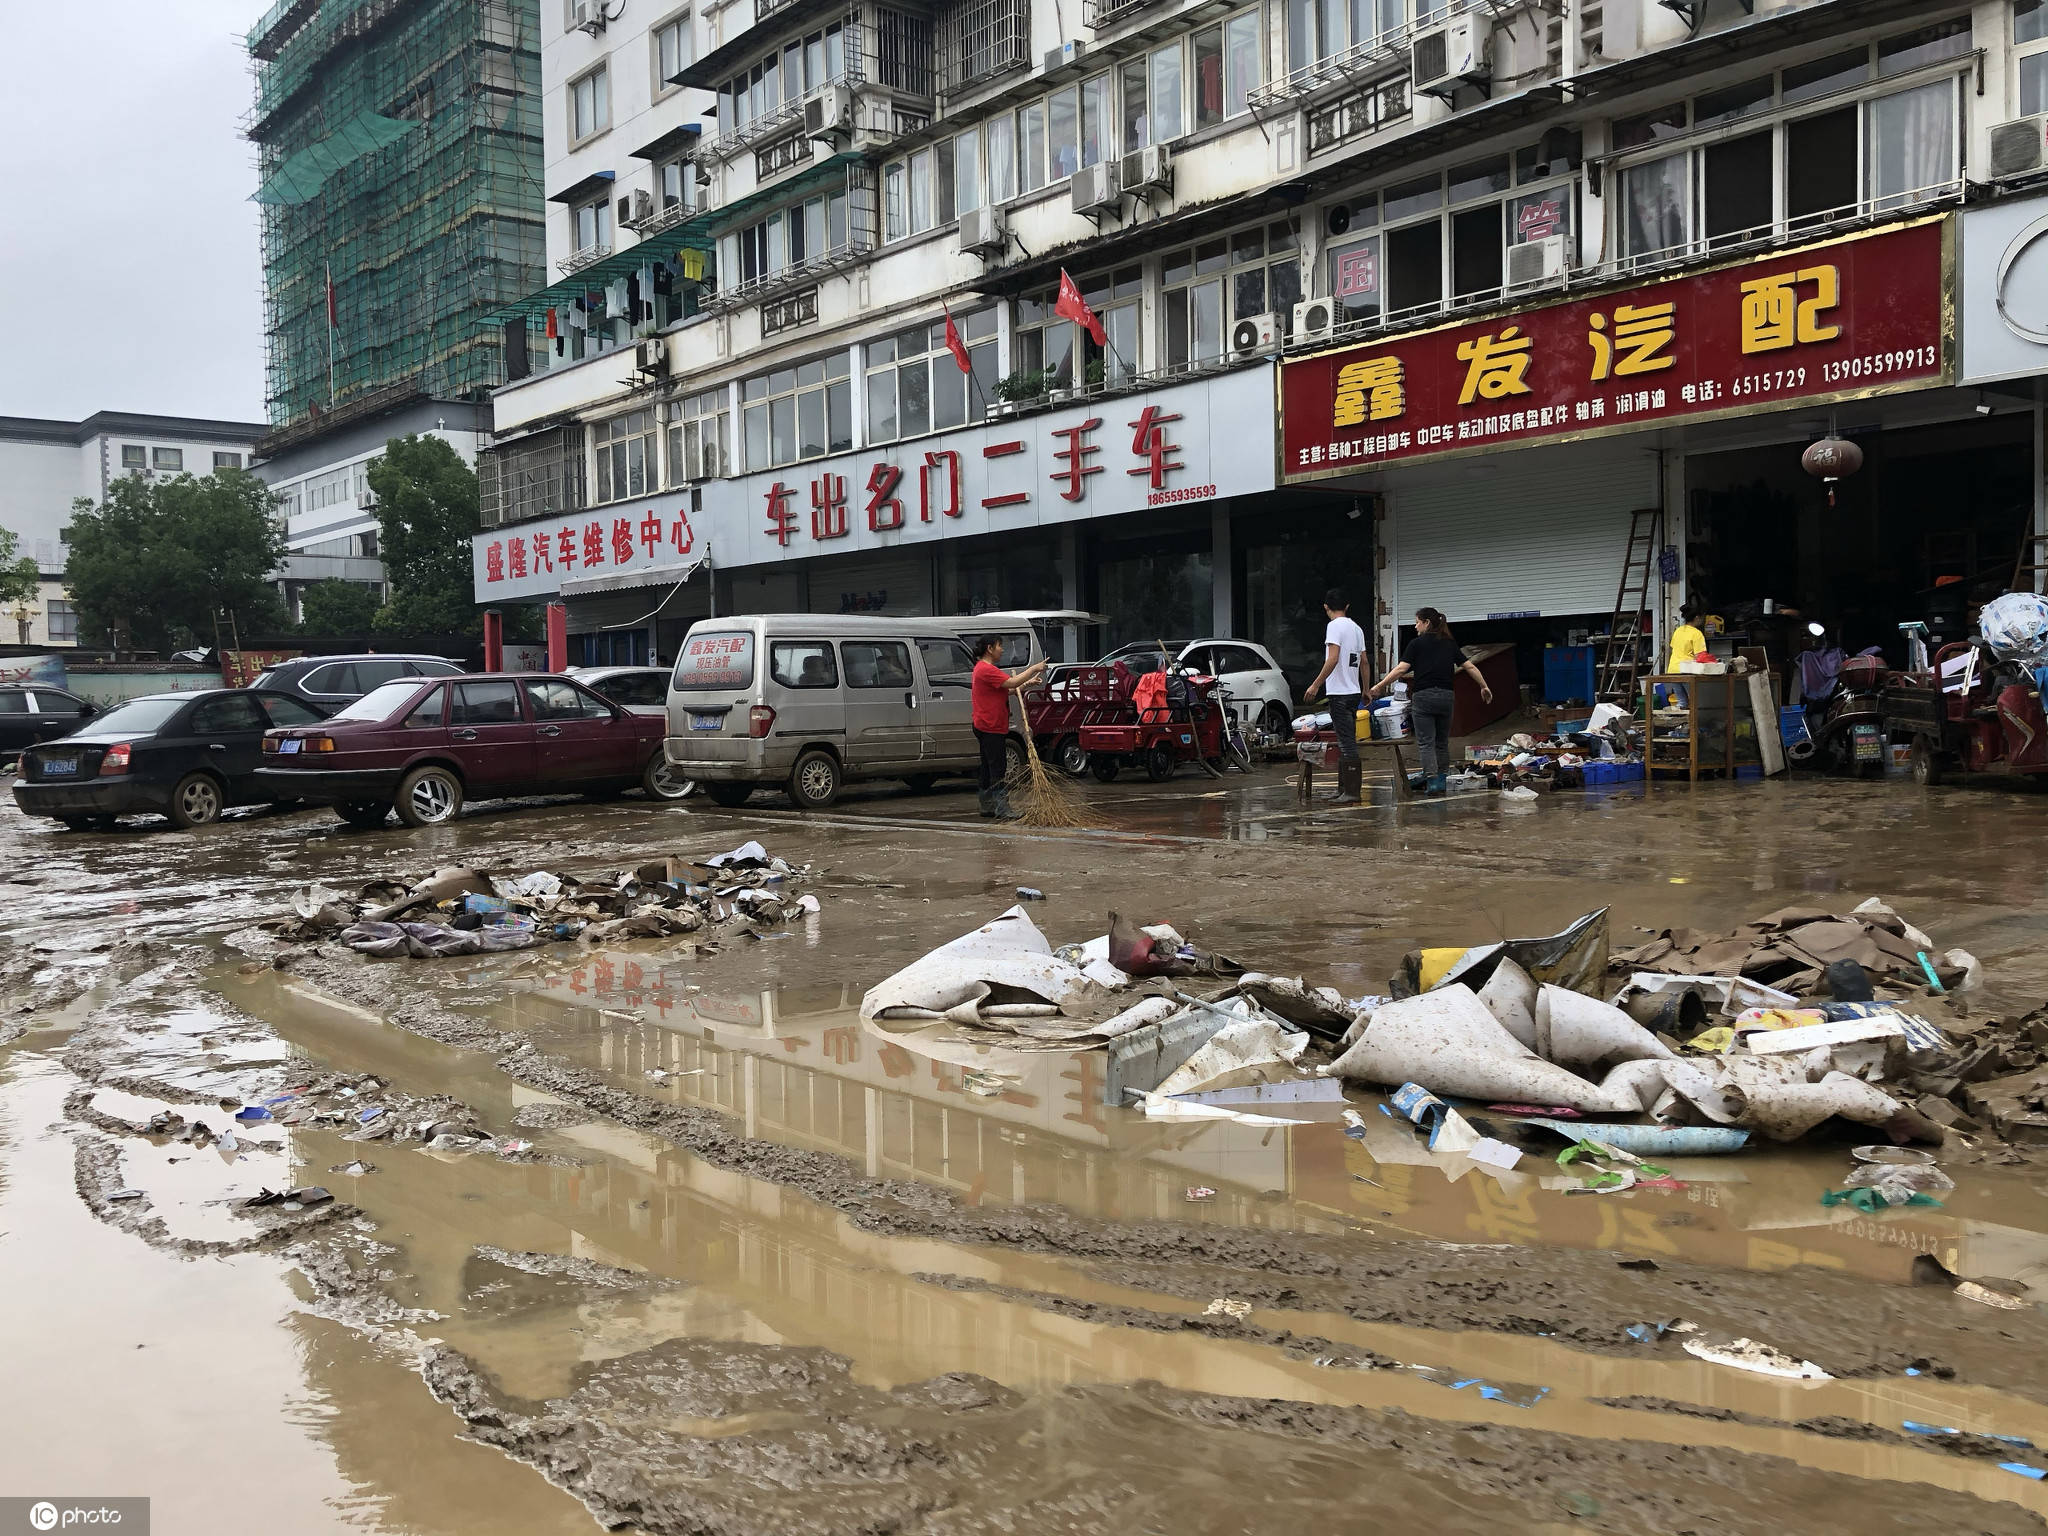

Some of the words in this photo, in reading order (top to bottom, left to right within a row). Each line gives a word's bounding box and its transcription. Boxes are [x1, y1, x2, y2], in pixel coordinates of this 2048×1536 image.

[1333, 264, 1842, 429] 鑫发汽配
[1417, 424, 1454, 446] 中巴车
[1458, 405, 1569, 440] 发动机及底盘配件
[1575, 398, 1605, 421] 轴承
[1615, 388, 1666, 414] 润滑油
[1823, 346, 1936, 383] 13905599913
[763, 405, 1187, 548] 车出名门二手车
[1148, 484, 1216, 505] 18655935593
[485, 507, 696, 585] 盛隆汽车维修中心
[689, 637, 746, 656] 鑫发汽配
